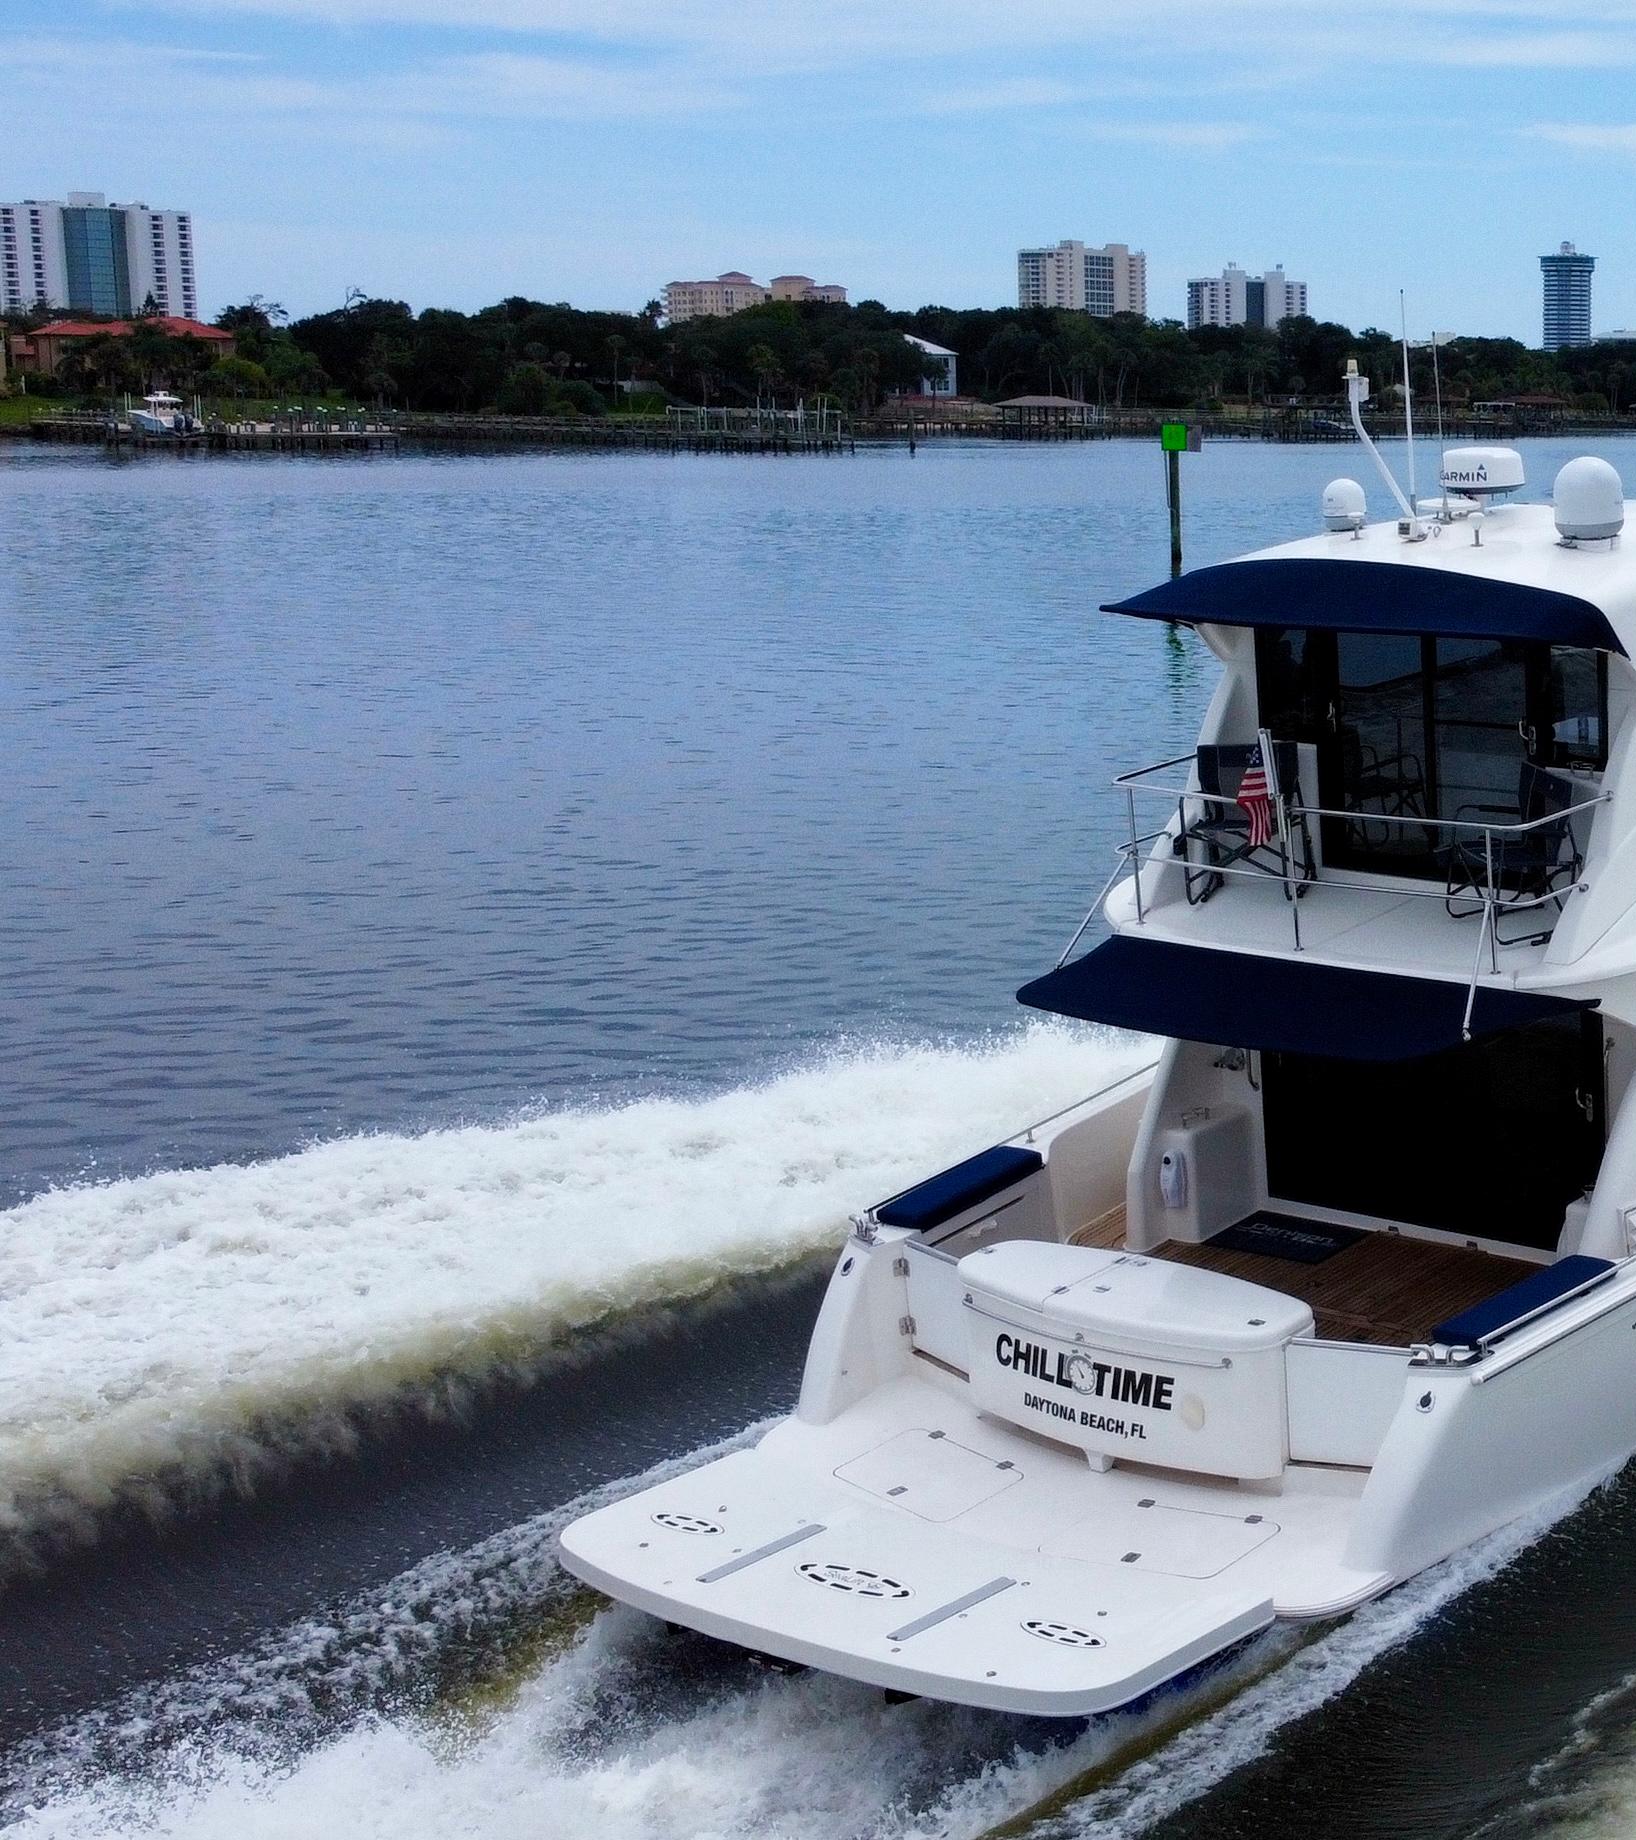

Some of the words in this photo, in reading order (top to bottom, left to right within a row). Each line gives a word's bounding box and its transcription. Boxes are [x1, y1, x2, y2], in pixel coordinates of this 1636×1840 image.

[996, 1333, 1073, 1389] CHILL
[1093, 1362, 1175, 1411] TIME
[1024, 1392, 1076, 1423] DAYTONA
[1080, 1411, 1128, 1439] BEACH,
[1131, 1423, 1147, 1439] FL
